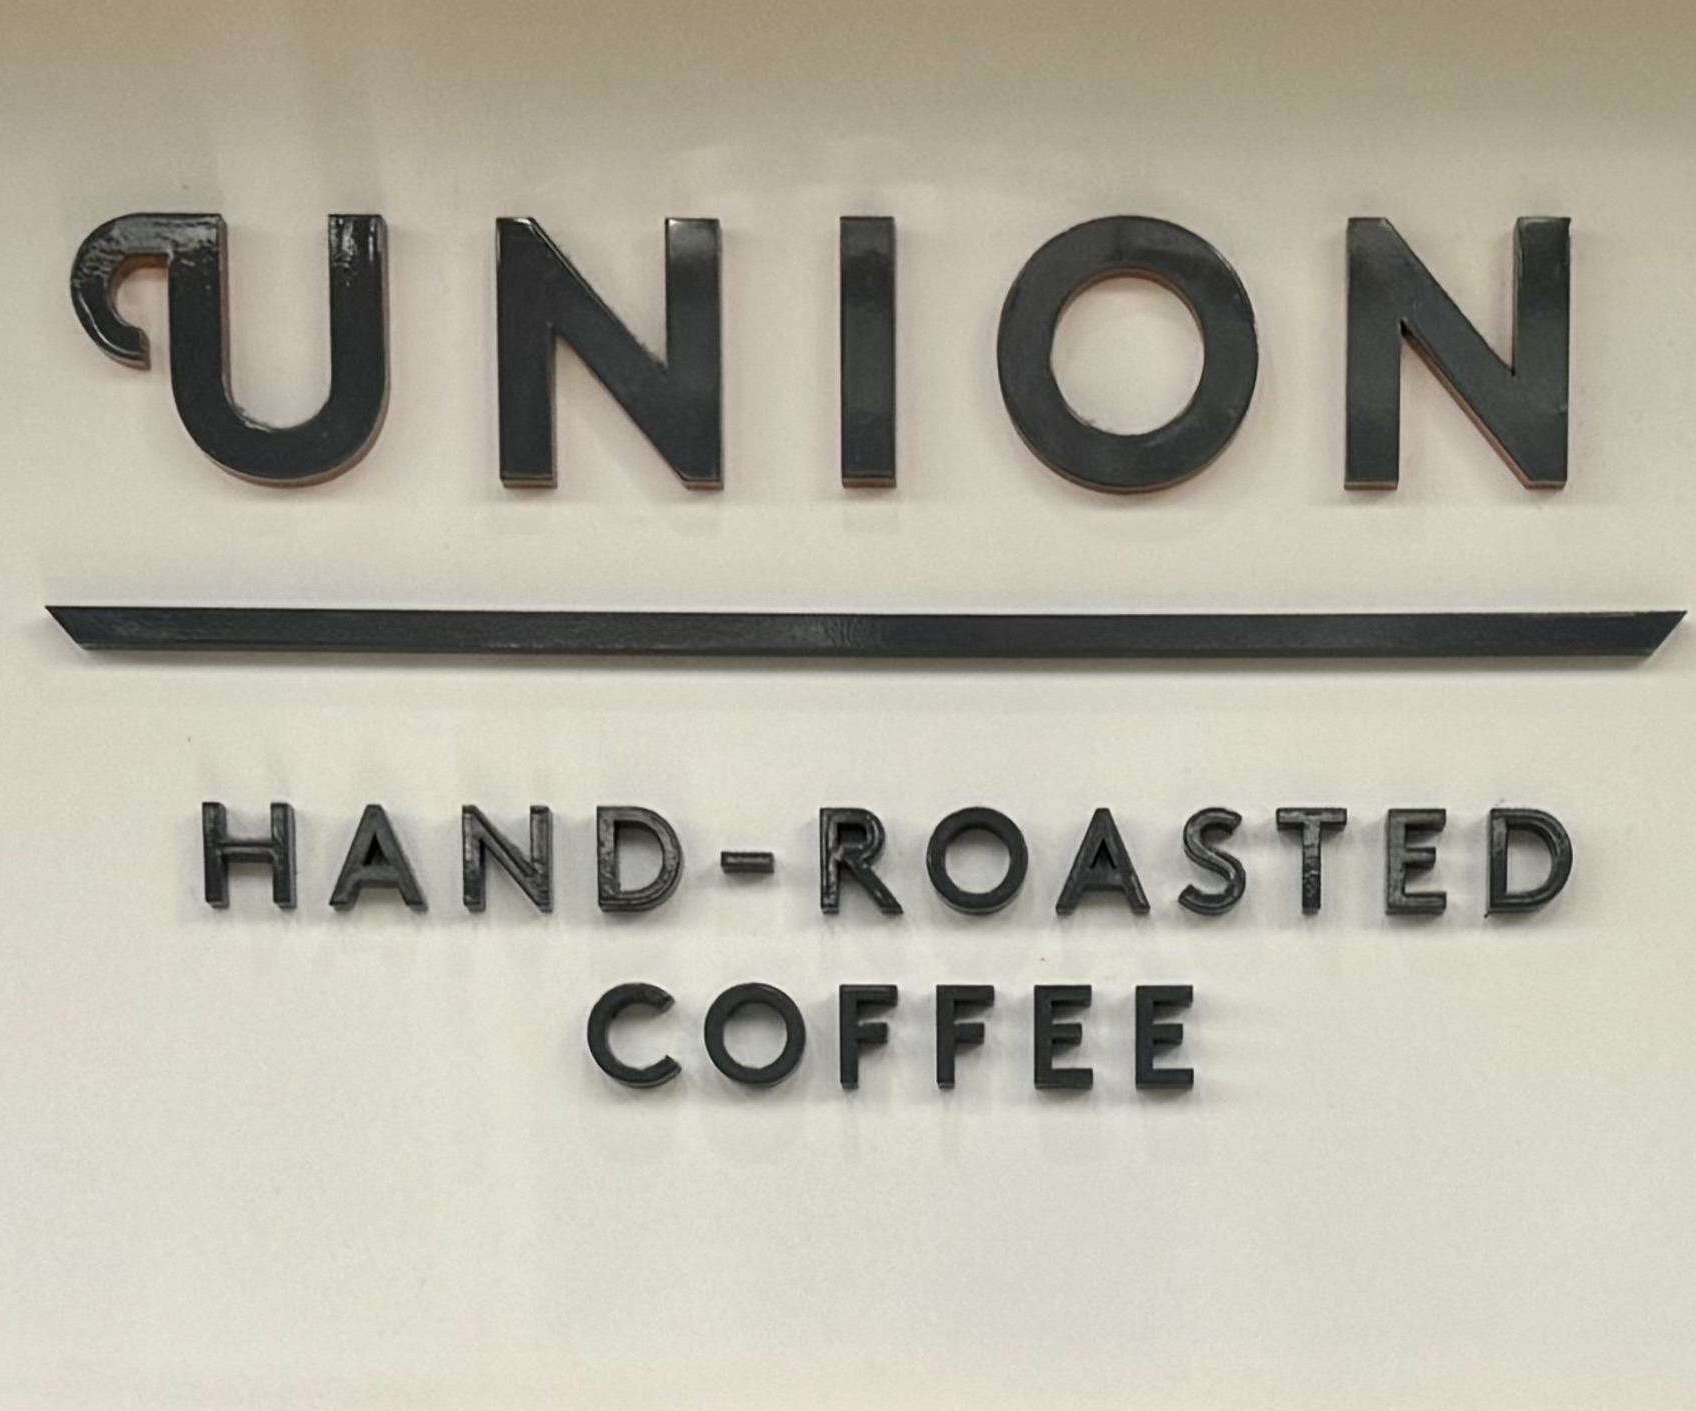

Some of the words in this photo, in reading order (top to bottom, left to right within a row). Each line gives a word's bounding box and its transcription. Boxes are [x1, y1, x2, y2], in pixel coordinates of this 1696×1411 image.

[69, 211, 1572, 492] UNION
[200, 801, 1573, 916] HAND-ROASTED
[586, 981, 1195, 1090] COFFEE
